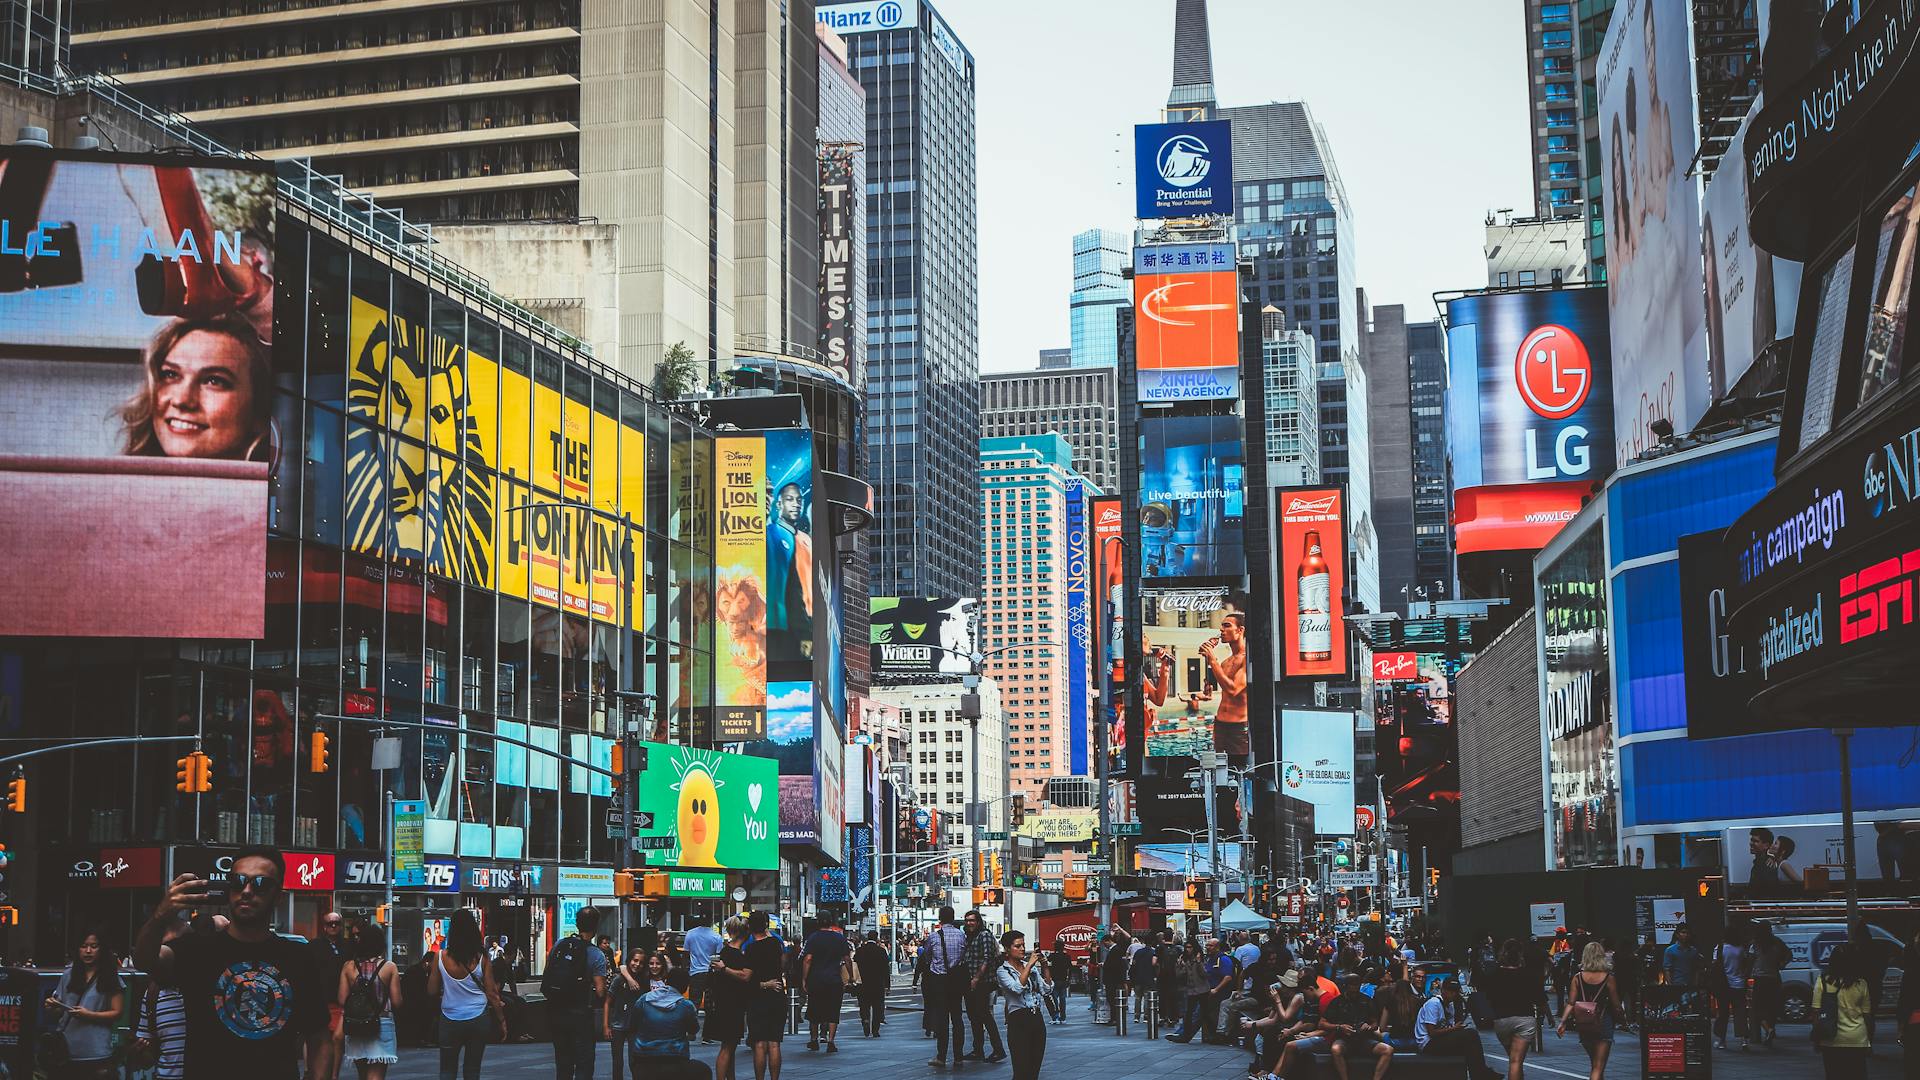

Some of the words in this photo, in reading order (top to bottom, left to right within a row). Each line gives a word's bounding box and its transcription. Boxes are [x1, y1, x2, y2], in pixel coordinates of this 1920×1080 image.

[1802, 68, 1852, 137] Night
[1855, 39, 1884, 91] Live
[1884, 14, 1898, 55] in
[1156, 187, 1212, 200] Prudential
[92, 226, 242, 265] HAAN
[824, 185, 849, 320] TIMES
[1724, 225, 1739, 259] cher
[1143, 251, 1225, 266] 新华通讯社
[1724, 275, 1744, 316] future
[1160, 374, 1218, 387] XINHUA
[1146, 388, 1180, 398] NEWS
[1183, 386, 1232, 397] AGENCY
[550, 430, 588, 484] THE
[1525, 425, 1591, 480] LG
[726, 472, 752, 485] THE
[1864, 468, 1885, 500] abc
[722, 488, 758, 508] LION
[1148, 489, 1172, 501] Live
[1175, 488, 1230, 501] beautiful
[508, 467, 571, 566] LION
[1291, 501, 1331, 511] Budweiser
[719, 510, 763, 536] KING
[1753, 529, 1765, 578] in
[1767, 488, 1845, 567] campaign
[1068, 500, 1085, 593] NOVOTEL
[533, 585, 559, 601] ENTRANCE
[564, 594, 573, 605] ON
[575, 597, 587, 609] 45TH
[592, 603, 607, 615] STREET
[1160, 594, 1222, 612] Coca-Cola
[1375, 654, 1414, 676] Ray-Ban
[1547, 688, 1564, 741] OLD
[1565, 669, 1593, 733] NAVY
[1305, 769, 1315, 779] THE
[1315, 770, 1334, 780] GLOBAL
[1334, 770, 1351, 780] GOALS
[744, 814, 767, 840] YOU
[1057, 824, 1078, 832] DOING
[1058, 830, 1081, 838] THERE?
[1113, 824, 1120, 833] W
[1121, 824, 1133, 833] 44
[643, 838, 651, 848] W
[654, 838, 665, 848] 44
[102, 857, 130, 879] Ray-Ban
[209, 872, 228, 881] OAK
[297, 857, 326, 887] Ray-Ban
[345, 861, 457, 887] SKRS
[490, 868, 532, 889] TISST
[673, 878, 688, 891] NEW
[688, 878, 704, 892] YORK
[711, 879, 723, 892] LINE
